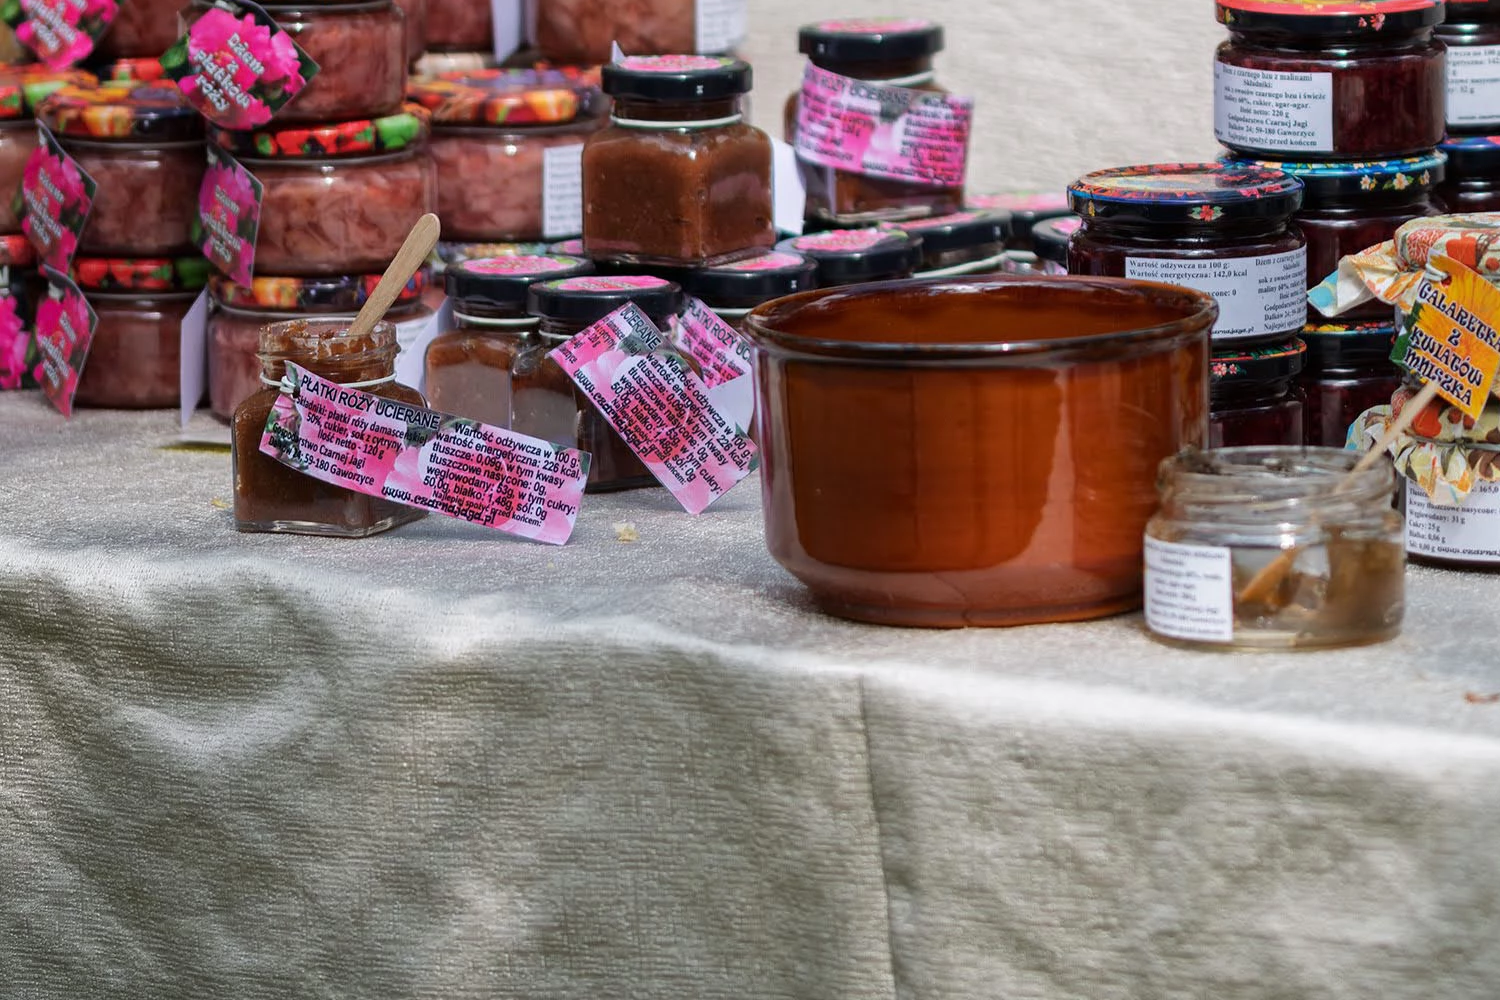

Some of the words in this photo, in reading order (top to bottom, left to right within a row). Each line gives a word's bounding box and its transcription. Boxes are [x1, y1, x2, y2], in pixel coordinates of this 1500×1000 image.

[1129, 268, 1158, 277] Wartość
[1160, 269, 1211, 280] energetyczna:
[1213, 269, 1231, 278] 142,0
[1233, 268, 1247, 277] kcal
[1130, 259, 1158, 268] Wartość
[1401, 350, 1475, 403] MNISZKA
[1408, 327, 1487, 383] KWIATÓW
[299, 374, 338, 401] PŁATKI
[338, 387, 374, 412] RÓŻY
[376, 400, 440, 430] UCIERANE
[327, 409, 350, 424] płatki
[351, 415, 368, 431] róży
[628, 368, 666, 410] tłuszczowe
[662, 410, 698, 449] nasycone:
[695, 448, 710, 462] 0g,
[637, 360, 668, 394] tłuszcze:
[665, 394, 688, 418] 0,09g,
[690, 425, 706, 441] tym
[704, 440, 728, 465] kwasy
[645, 352, 676, 384] wartość
[670, 384, 718, 436] energetyczna:
[716, 434, 732, 450] 226
[728, 450, 747, 469] kcal,
[664, 356, 695, 389] Wartość
[690, 390, 726, 428] odżywcza
[730, 434, 745, 449] 100
[740, 449, 752, 460] g:
[323, 420, 350, 437] cukier,
[350, 429, 365, 441] sok
[335, 435, 357, 450] netto
[363, 443, 378, 456] 120
[453, 422, 495, 443] Wartość
[495, 435, 542, 457] odżywcza
[544, 450, 552, 458] w
[553, 450, 569, 463] 100
[570, 457, 580, 468] g:
[610, 382, 634, 406] 50,0g,
[630, 405, 656, 432] białko:
[653, 431, 675, 454] 1,48g,
[672, 453, 688, 470] sól:
[684, 468, 696, 480] 0g
[618, 376, 667, 430] węglowodany:
[664, 429, 682, 447] 53g,
[685, 453, 702, 469] tym
[698, 468, 722, 493] cukry:
[303, 453, 329, 471] 59-180
[330, 462, 375, 486] Gaworzyce
[319, 444, 348, 465] Czarnej
[348, 454, 366, 469] Jagi
[429, 454, 482, 476] tłuszczowe
[482, 469, 531, 490] nasycone:
[532, 482, 547, 495] 0g,
[431, 442, 474, 461] tłuszcze:
[475, 453, 505, 471] 0,09g,
[506, 464, 515, 472] w
[516, 465, 534, 479] tym
[535, 471, 565, 488] kwasy
[435, 432, 473, 449] wartość
[474, 442, 540, 469] energetyczna:
[542, 460, 559, 473] 226
[559, 465, 582, 481] kcal,
[422, 475, 452, 493] 50,0g,
[453, 484, 485, 501] białko:
[487, 494, 514, 511] 1,48g,
[515, 502, 534, 515] sól:
[534, 508, 547, 521] 0g
[425, 465, 494, 492] węglowodany:
[495, 482, 516, 498] 53g,
[517, 491, 526, 500] w
[528, 494, 546, 507] tym
[546, 499, 575, 516] cukry:
